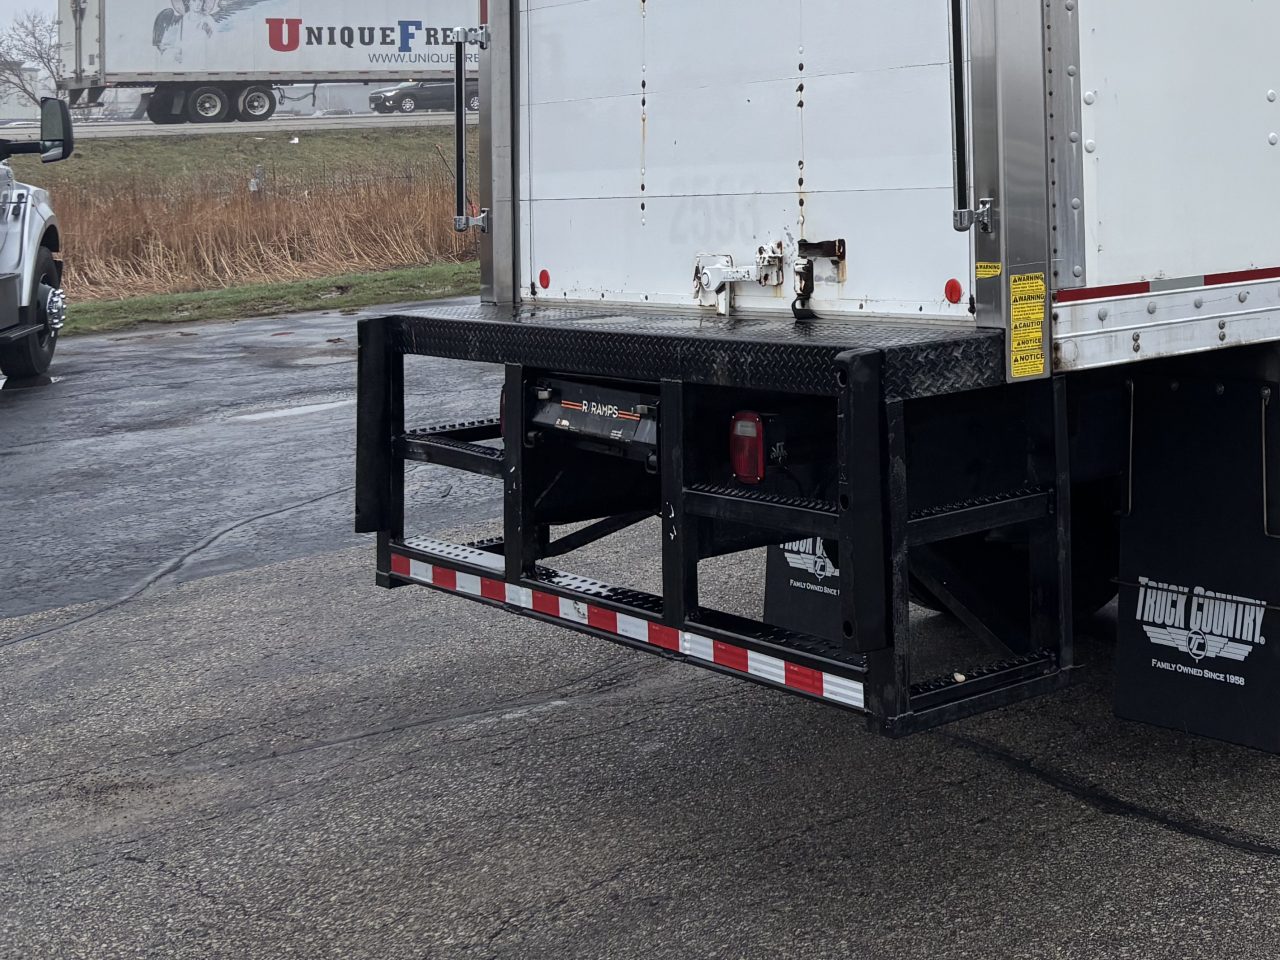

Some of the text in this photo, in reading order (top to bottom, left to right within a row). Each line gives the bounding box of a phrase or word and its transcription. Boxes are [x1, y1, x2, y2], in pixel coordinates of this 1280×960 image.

[368, 53, 479, 63] WWW.UNIQUERE
[1020, 353, 1044, 361] NOTICE
[789, 579, 806, 589] FAMILY
[806, 582, 823, 592] OWNED
[823, 586, 837, 596] SINCE
[1136, 576, 1189, 628] TRUCK
[1151, 658, 1245, 686] FAMILY OWNED SINCE 1958
